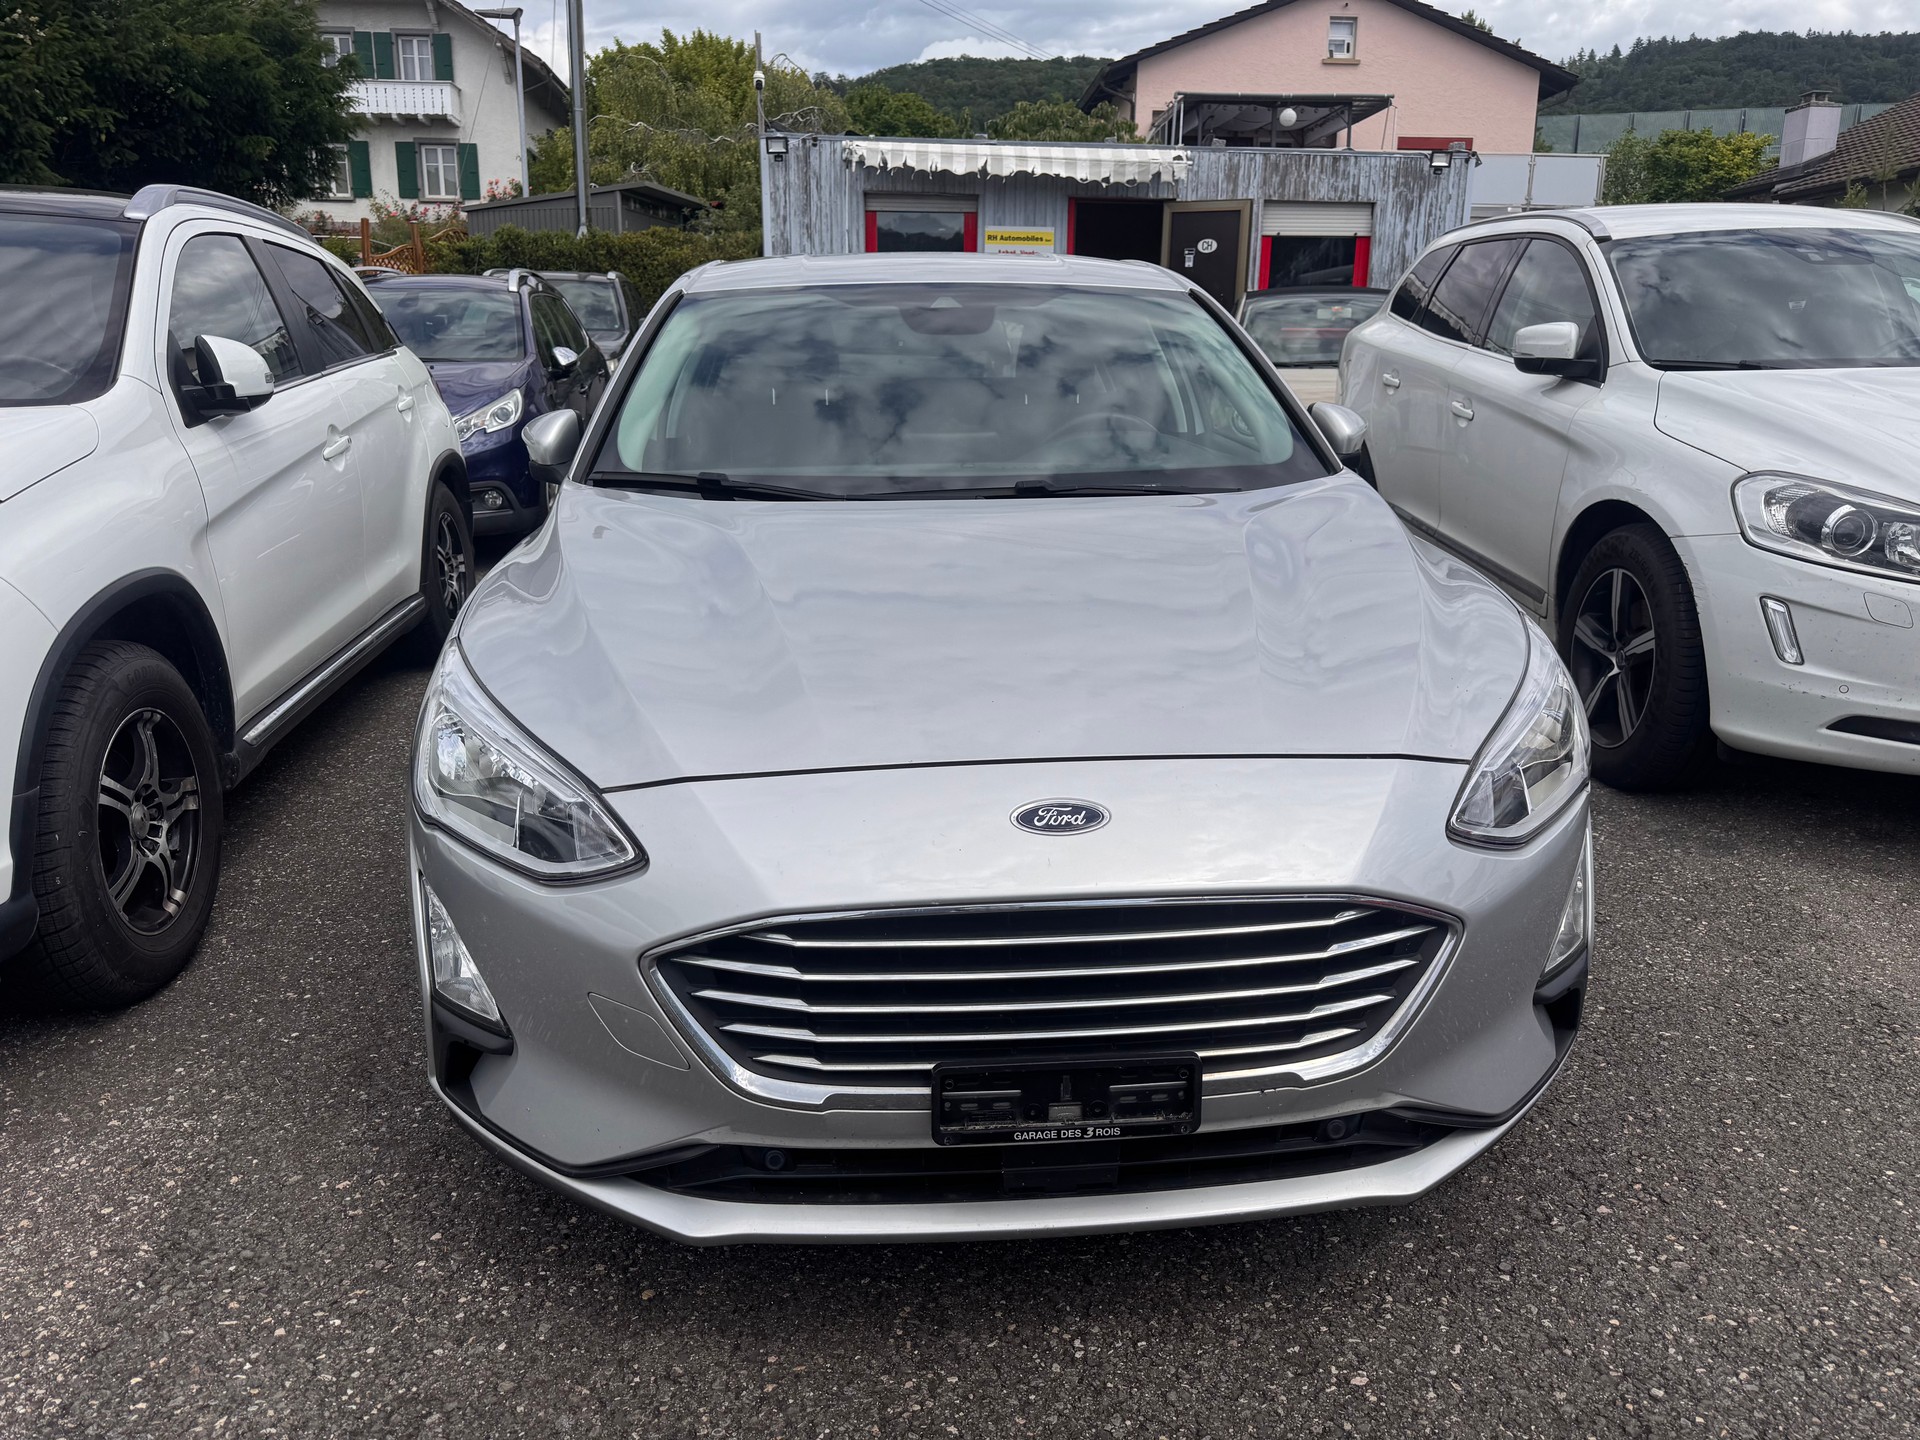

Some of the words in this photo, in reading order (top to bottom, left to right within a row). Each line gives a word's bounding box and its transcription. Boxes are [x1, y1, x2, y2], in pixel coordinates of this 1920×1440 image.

[1202, 240, 1213, 251] CH
[1034, 806, 1086, 827] Ford
[1013, 1130, 1058, 1141] GARAGE
[1060, 1129, 1082, 1138] DES
[1083, 1126, 1095, 1138] 3
[1095, 1127, 1121, 1137] ROIS
